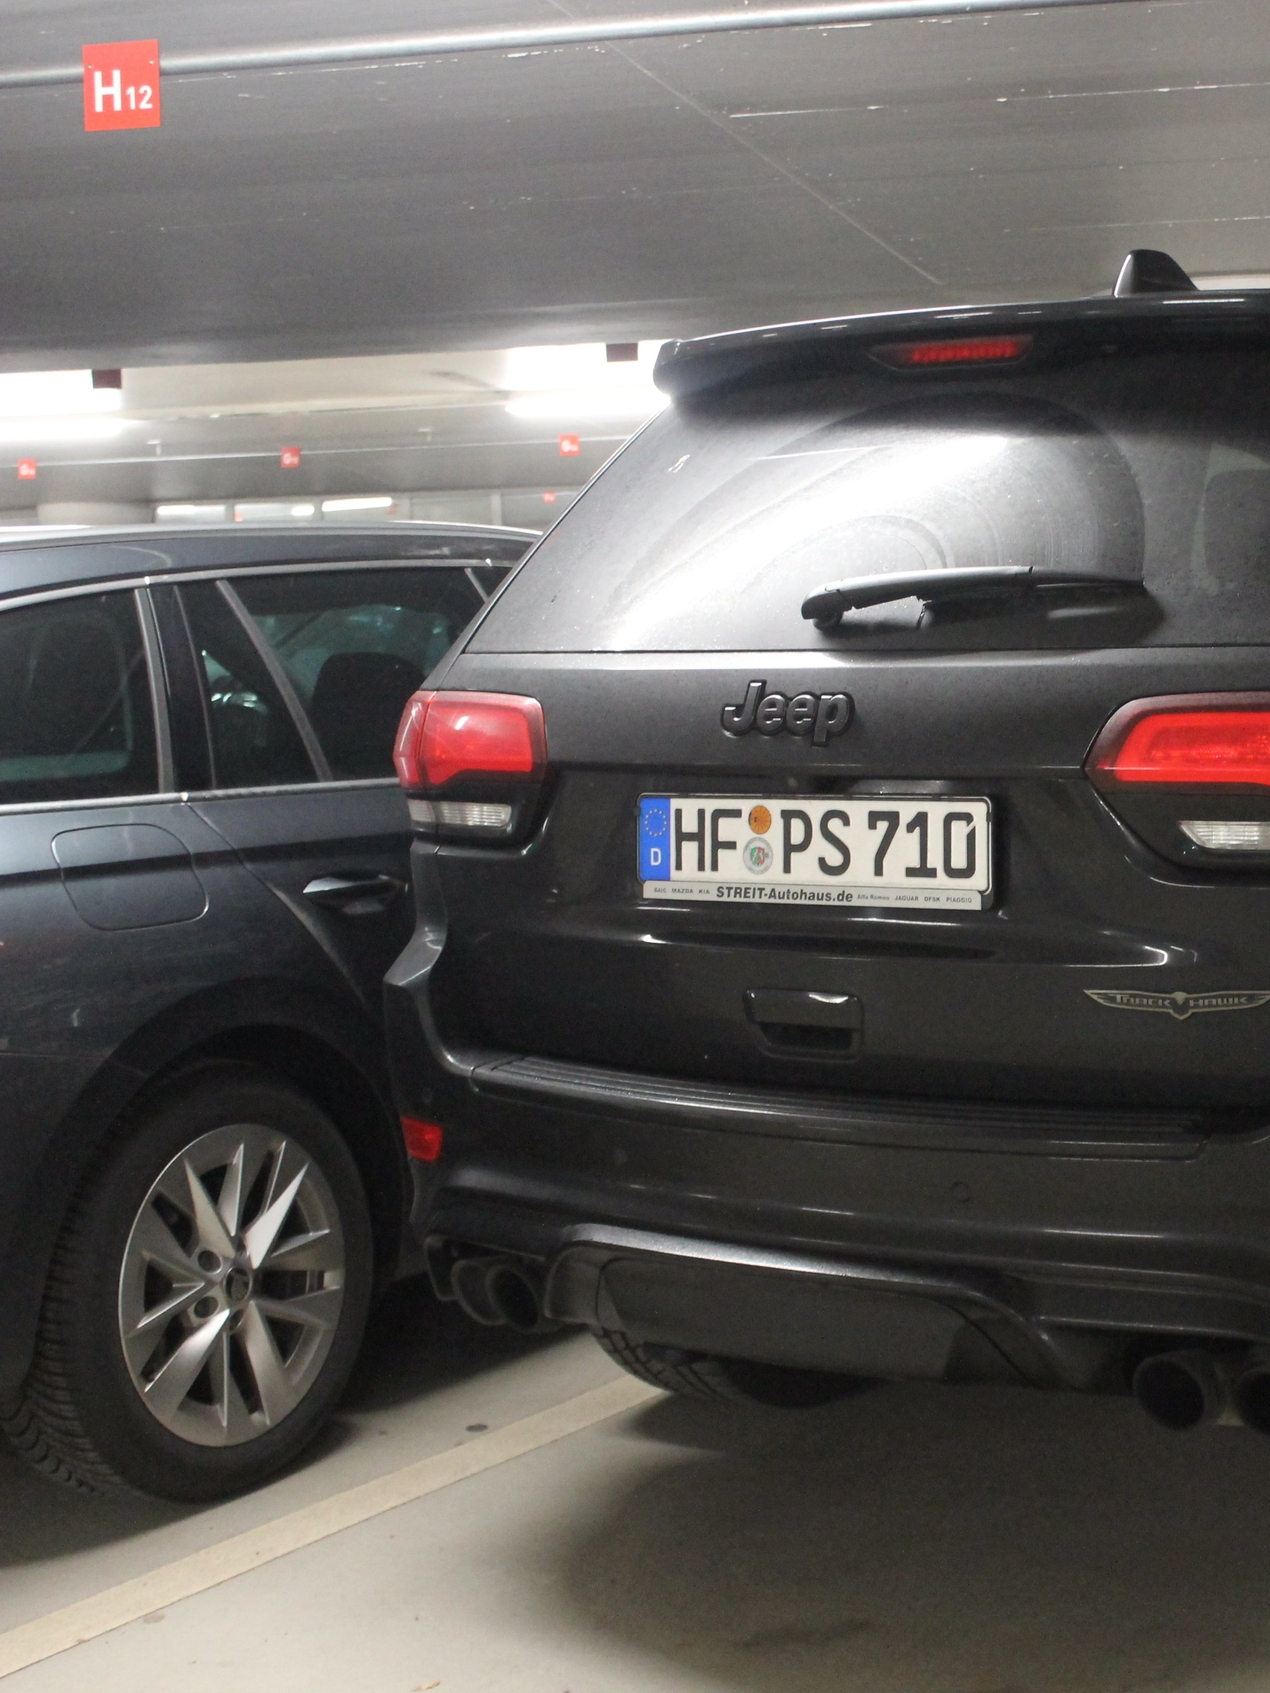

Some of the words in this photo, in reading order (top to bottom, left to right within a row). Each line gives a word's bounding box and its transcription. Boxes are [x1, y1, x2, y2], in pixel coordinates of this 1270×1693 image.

[94, 69, 153, 113] H12
[720, 679, 855, 747] Jeep
[649, 848, 661, 866] D
[674, 808, 742, 872] HF
[780, 809, 851, 876] PS
[868, 810, 976, 879] 710
[716, 885, 853, 902] STREIT-Autohaus.de
[946, 896, 972, 904] PIAGGIO
